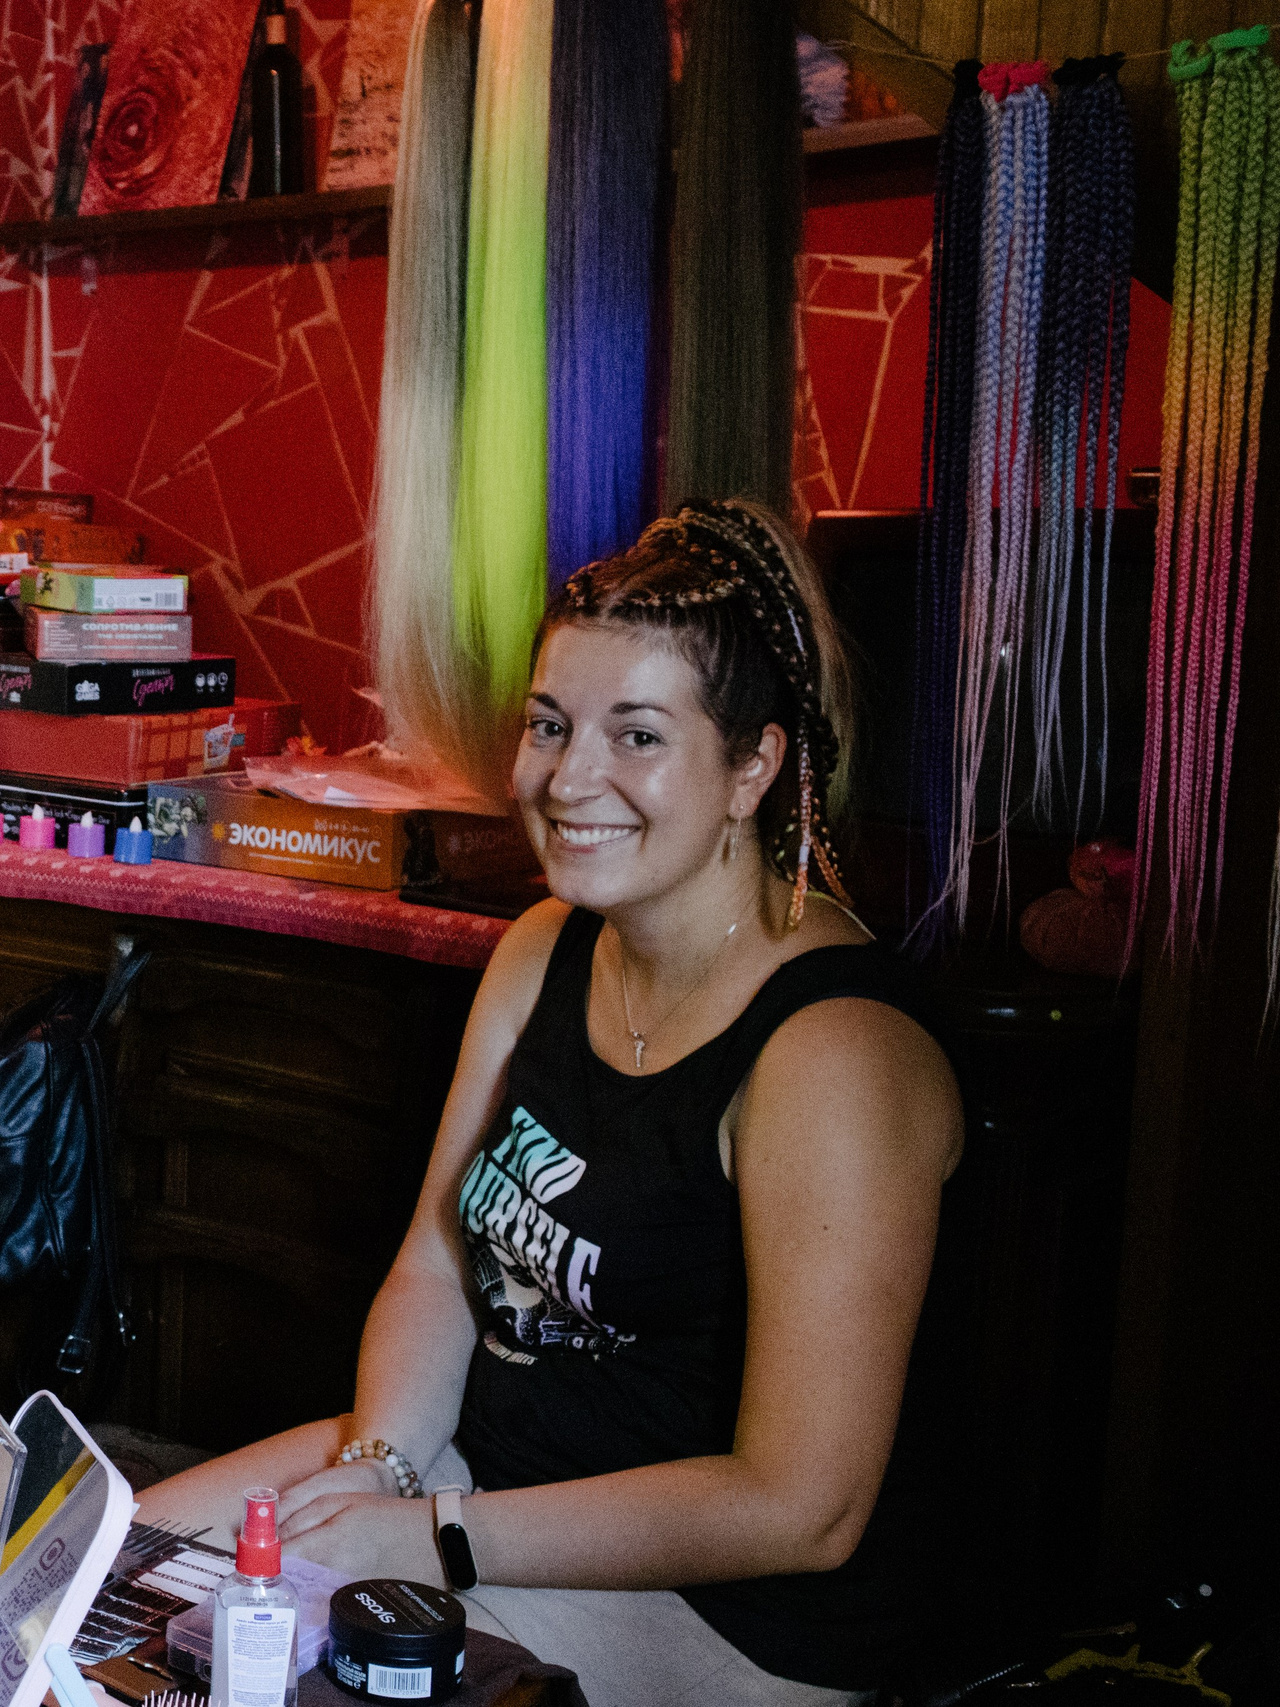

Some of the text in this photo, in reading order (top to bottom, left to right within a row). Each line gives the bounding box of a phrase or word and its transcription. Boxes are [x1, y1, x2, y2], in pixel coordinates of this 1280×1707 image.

[81, 622, 179, 632] СОПРОТИВЛЕНИЕ
[229, 822, 381, 864] ЭКОНОМИКУС
[491, 1105, 587, 1204] FIND
